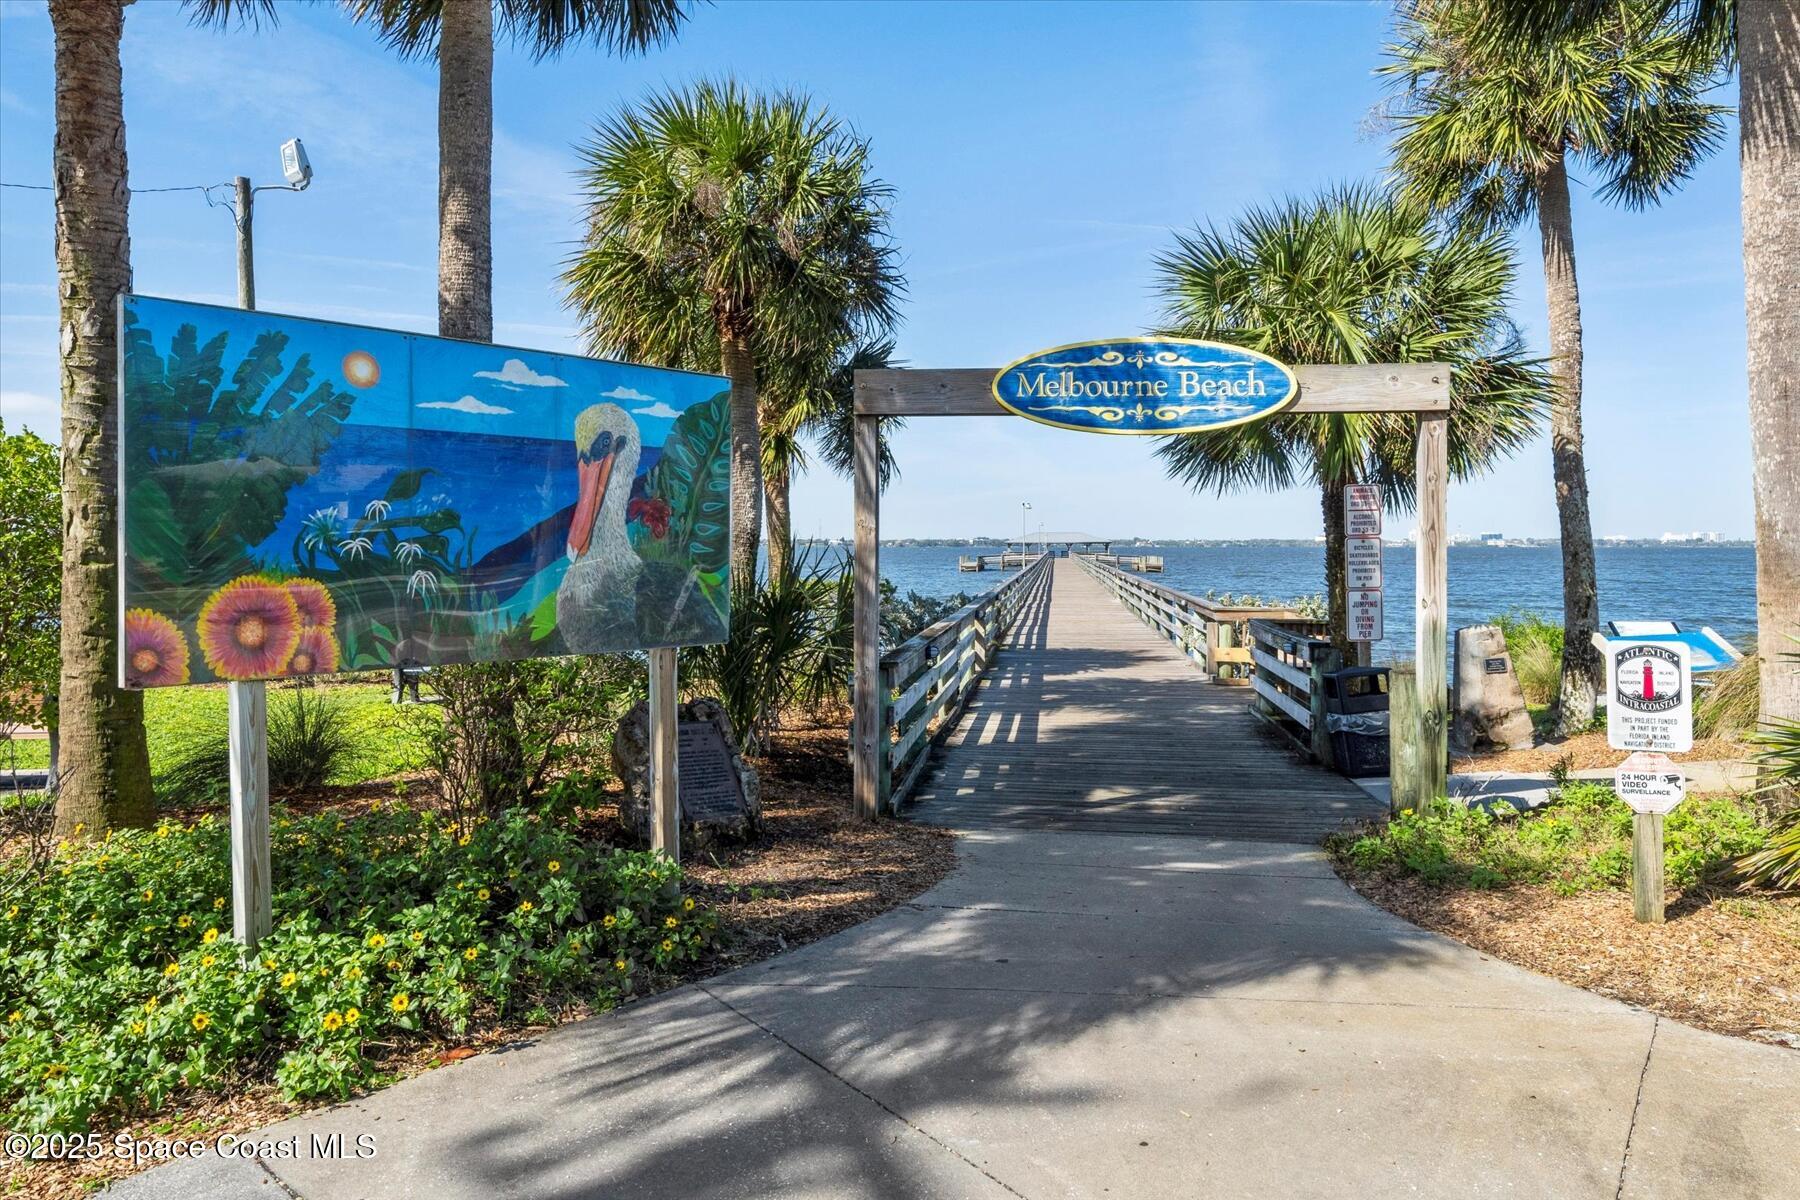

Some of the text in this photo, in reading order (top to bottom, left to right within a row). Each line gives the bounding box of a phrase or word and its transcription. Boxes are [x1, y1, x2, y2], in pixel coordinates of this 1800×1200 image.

[1016, 370, 1266, 398] Melbourne Beach
[1352, 600, 1378, 608] JUMPING
[1623, 647, 1673, 662] ATLANTIC
[1619, 694, 1679, 711] INTRACOASTAL
